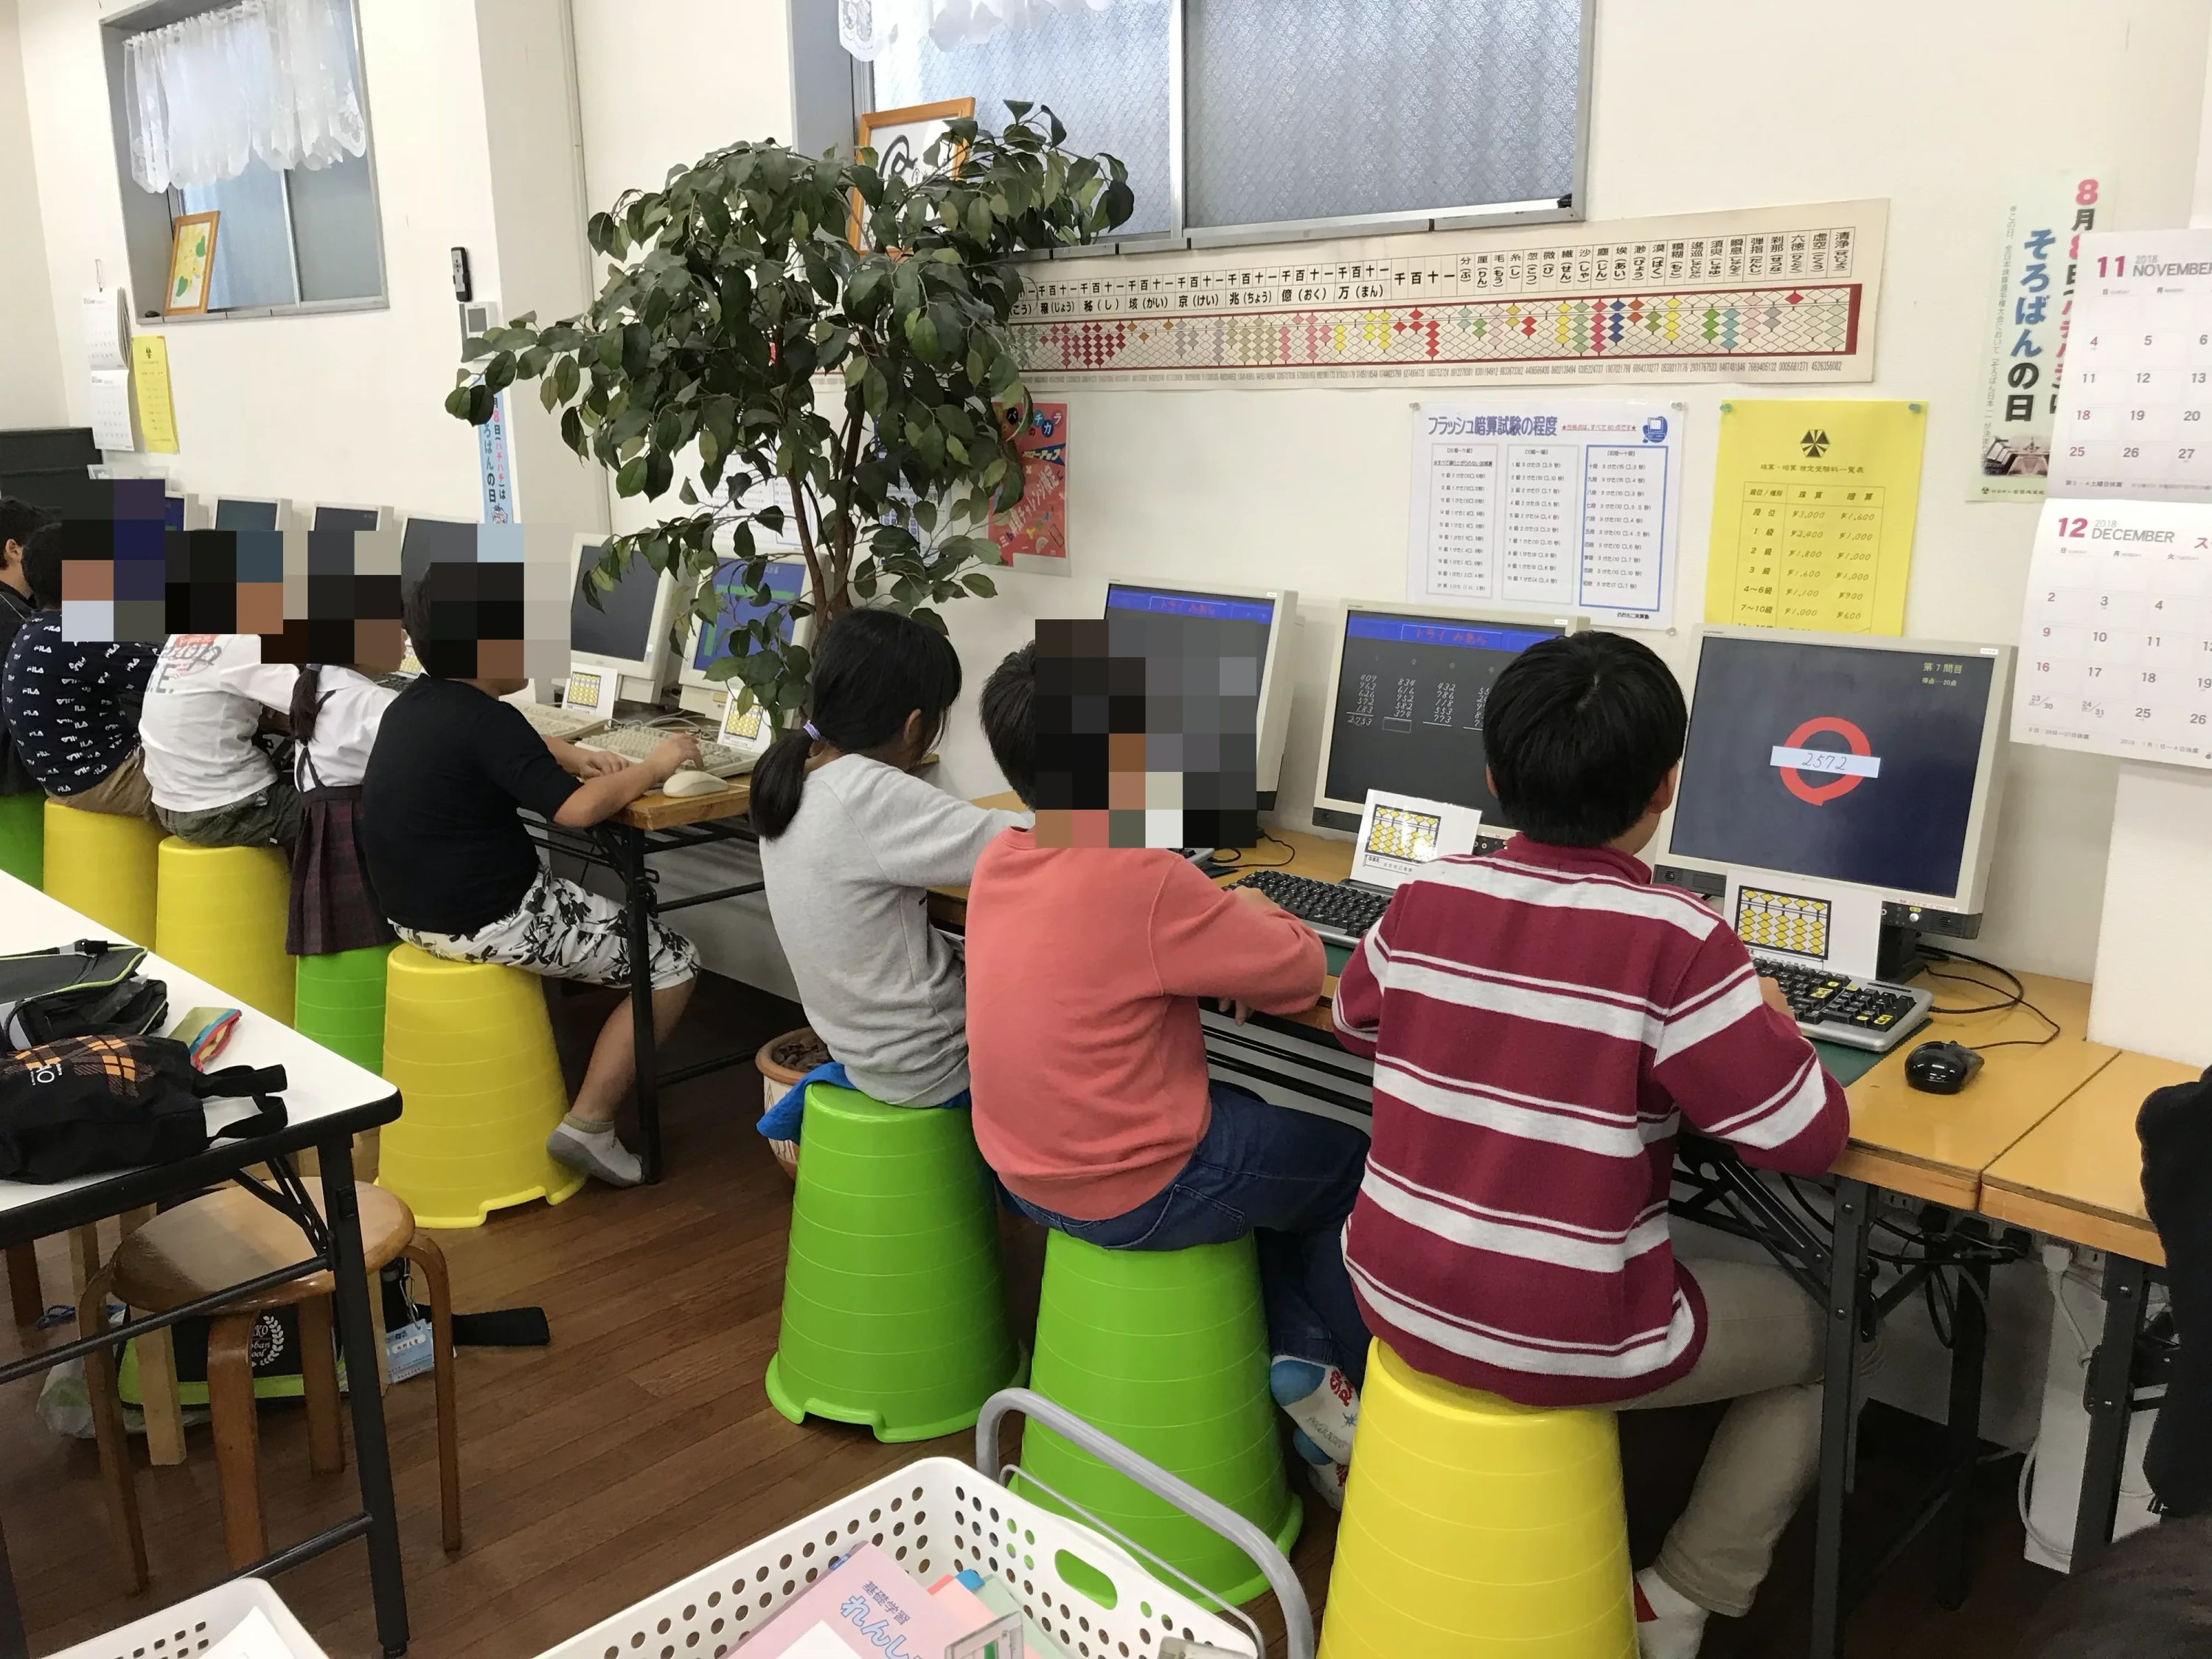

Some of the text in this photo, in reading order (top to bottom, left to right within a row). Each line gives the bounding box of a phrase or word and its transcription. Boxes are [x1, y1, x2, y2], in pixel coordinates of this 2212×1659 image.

[2005, 229, 2056, 422] そろばんの日
[2090, 335, 2208, 347] 4 5 6
[2082, 372, 2207, 383] 11 12 13
[2076, 410, 2201, 422] 18 19 20
[1427, 416, 1558, 436] フラッシュ暗算試験の程度
[2070, 447, 2195, 459] 25 26 27
[2058, 518, 2088, 538] 12
[2091, 528, 2175, 543] DECEMBER
[2048, 592, 2163, 611] 2 3 4
[2043, 627, 2051, 637] 9
[2093, 631, 2107, 643] 10
[2147, 636, 2161, 647] 11
[2037, 662, 2212, 689] 16 17 18 19
[1438, 683, 1455, 691] 432
[1437, 691, 1454, 699] 786
[1357, 698, 1374, 706] 572
[1395, 702, 1412, 710] 582
[1436, 699, 1453, 707] 118
[1394, 710, 1411, 718] 374
[1434, 707, 1453, 715] 553
[2135, 708, 2152, 718] 25
[2190, 714, 2207, 725] 26
[1348, 716, 1371, 726] 2753
[1433, 715, 1451, 723] 773
[1801, 752, 1848, 771] 2572
[861, 1580, 911, 1626] 基礎学習
[841, 1595, 923, 1659] れんし
